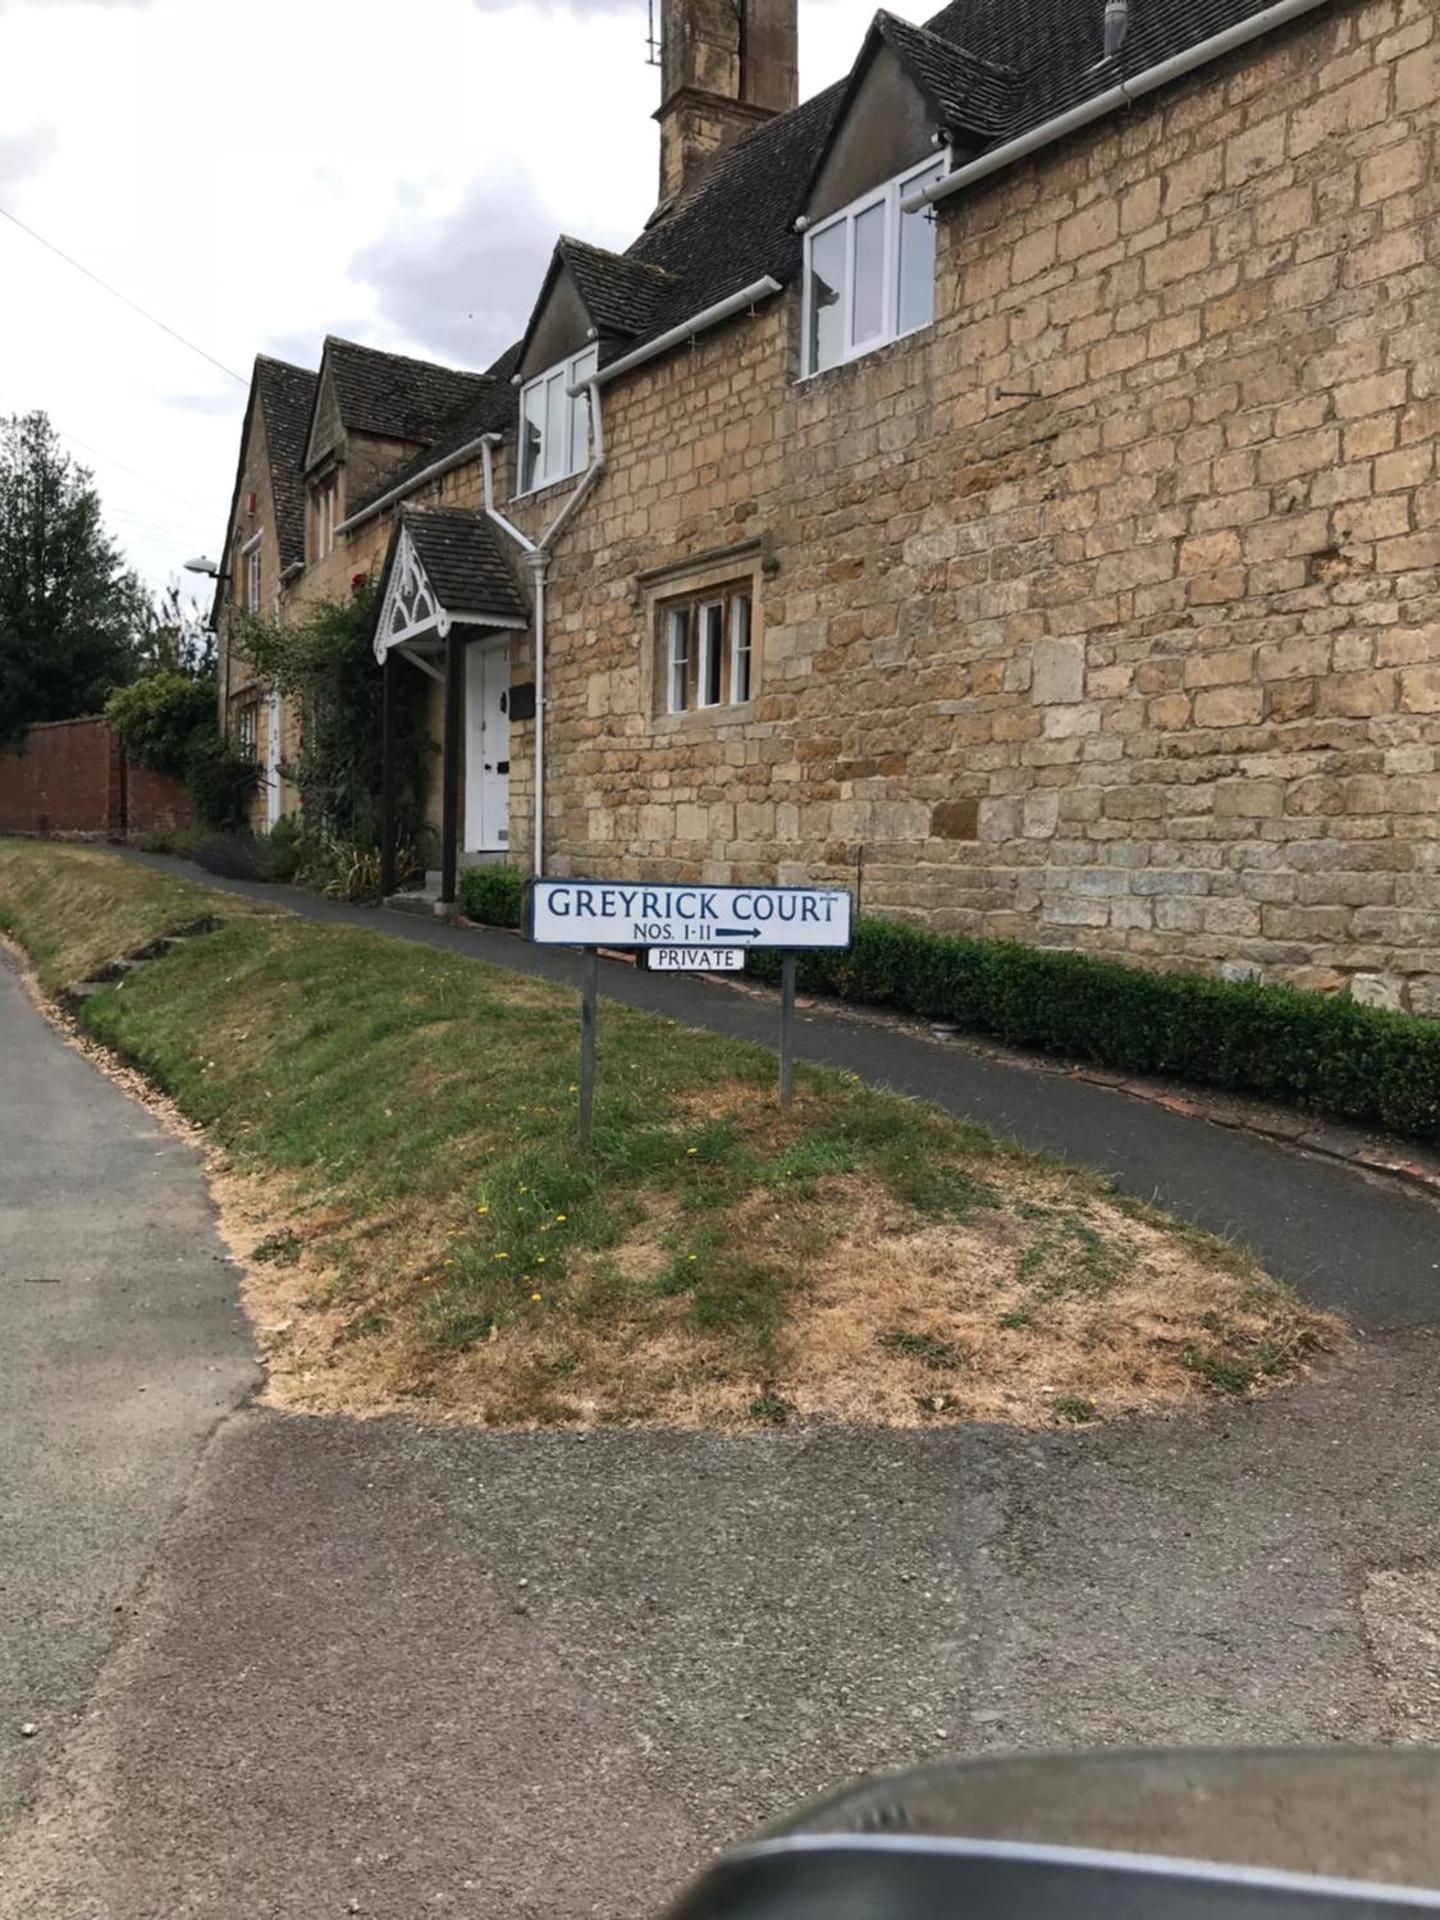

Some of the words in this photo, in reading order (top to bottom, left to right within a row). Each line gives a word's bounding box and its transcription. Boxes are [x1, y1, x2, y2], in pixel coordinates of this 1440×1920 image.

[548, 888, 719, 919] GREYRICK
[732, 894, 839, 921] COURT
[633, 923, 675, 940] NOS.
[658, 950, 734, 966] PRIVATE
